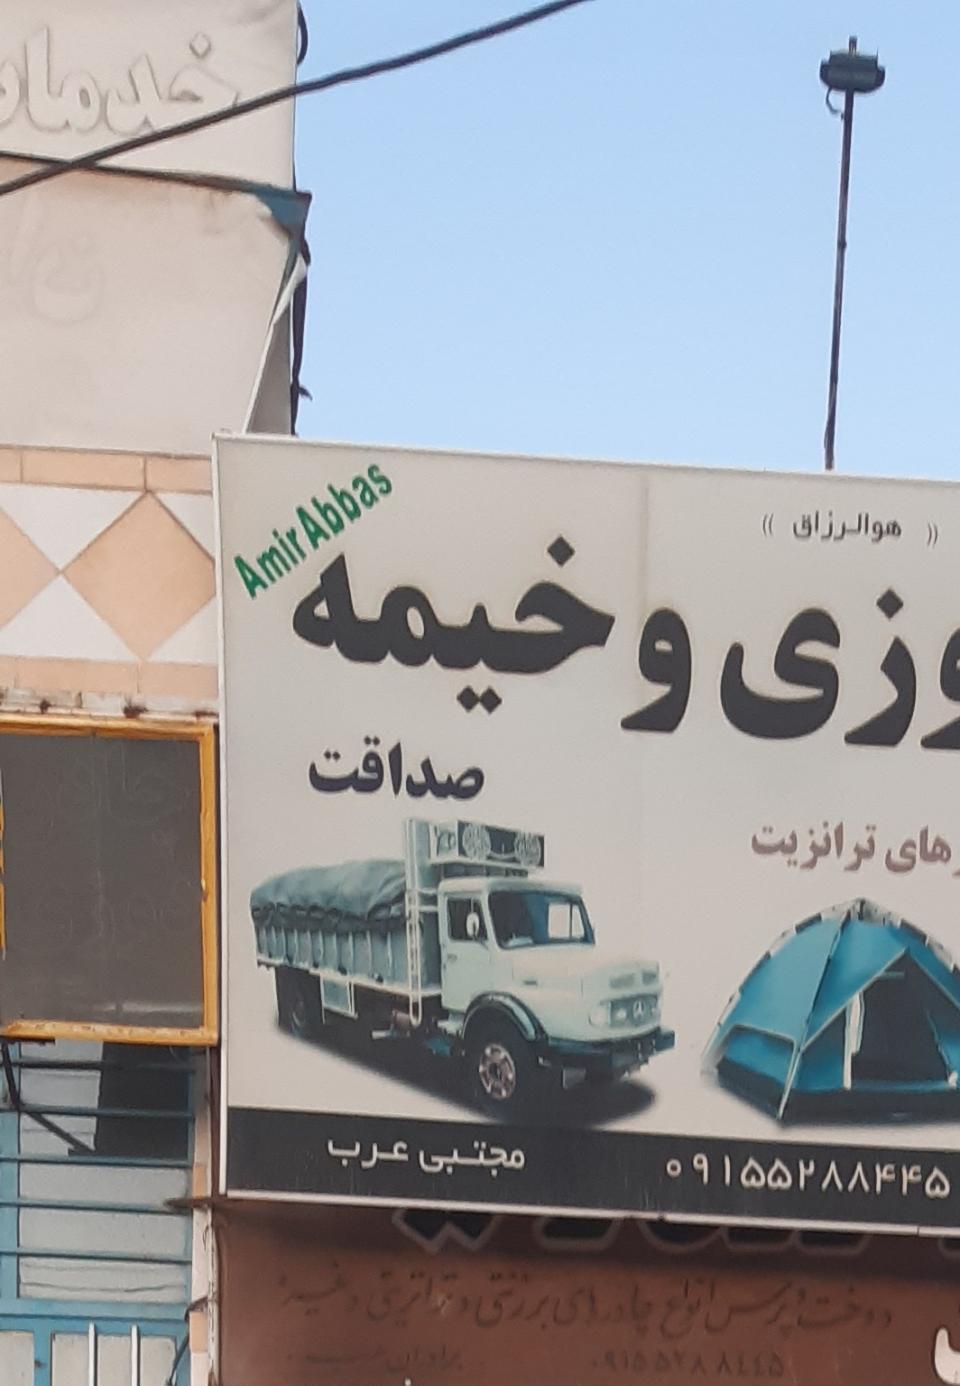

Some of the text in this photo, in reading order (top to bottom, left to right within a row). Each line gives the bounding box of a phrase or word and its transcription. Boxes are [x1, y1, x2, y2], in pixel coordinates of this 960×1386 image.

[0, 27, 238, 134] خدما
[234, 464, 392, 599] AmirAbbas
[308, 734, 485, 802] صداقت
[751, 820, 877, 875] ترانزیت
[327, 1139, 525, 1177] مجتبی عرب
[666, 1153, 951, 1199] ۰۹۱۵۵۲۸۸۴۴۵
